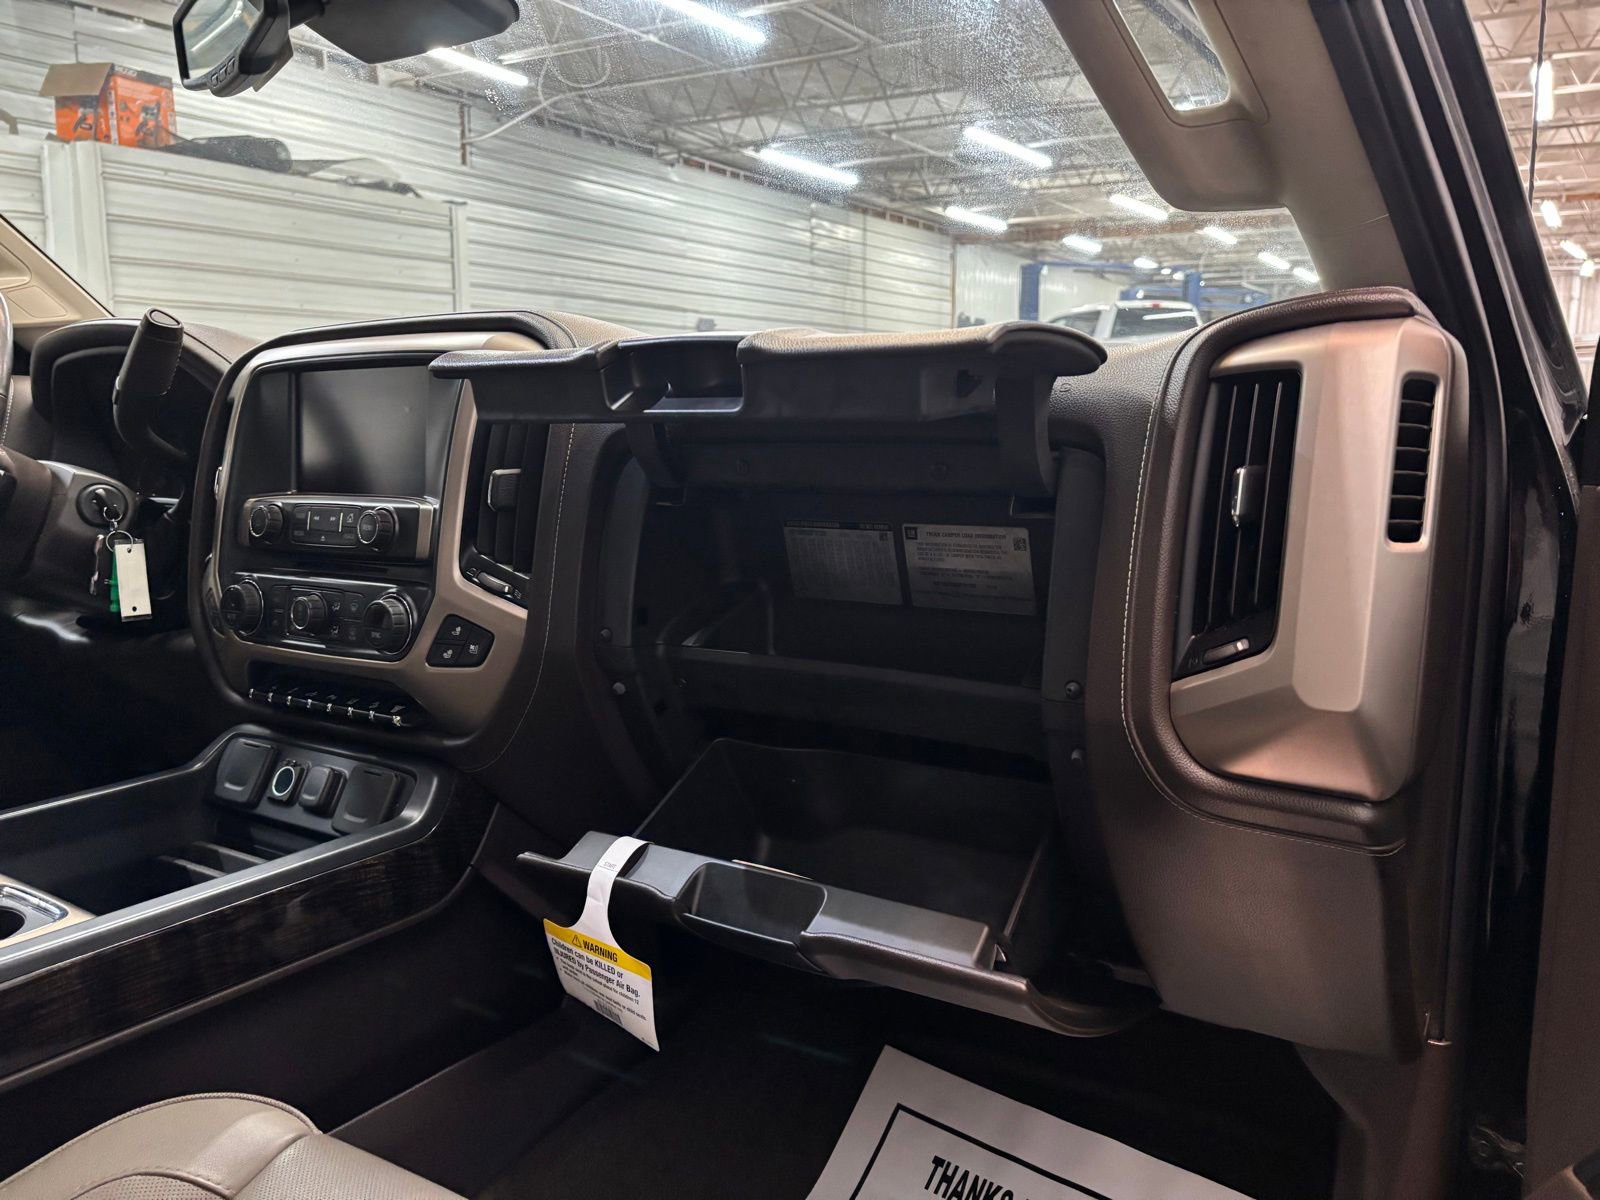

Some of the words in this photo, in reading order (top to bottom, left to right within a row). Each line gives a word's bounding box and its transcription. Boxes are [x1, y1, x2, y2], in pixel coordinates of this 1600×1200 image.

[551, 937, 574, 955] Children
[574, 951, 586, 961] can
[586, 955, 594, 965] be
[594, 959, 616, 975] KILLED
[617, 971, 624, 979] or
[583, 939, 618, 963] WARNING
[577, 959, 585, 971] by
[585, 963, 615, 985] Passenger
[616, 979, 625, 990] Air
[626, 984, 641, 998] Bag.
